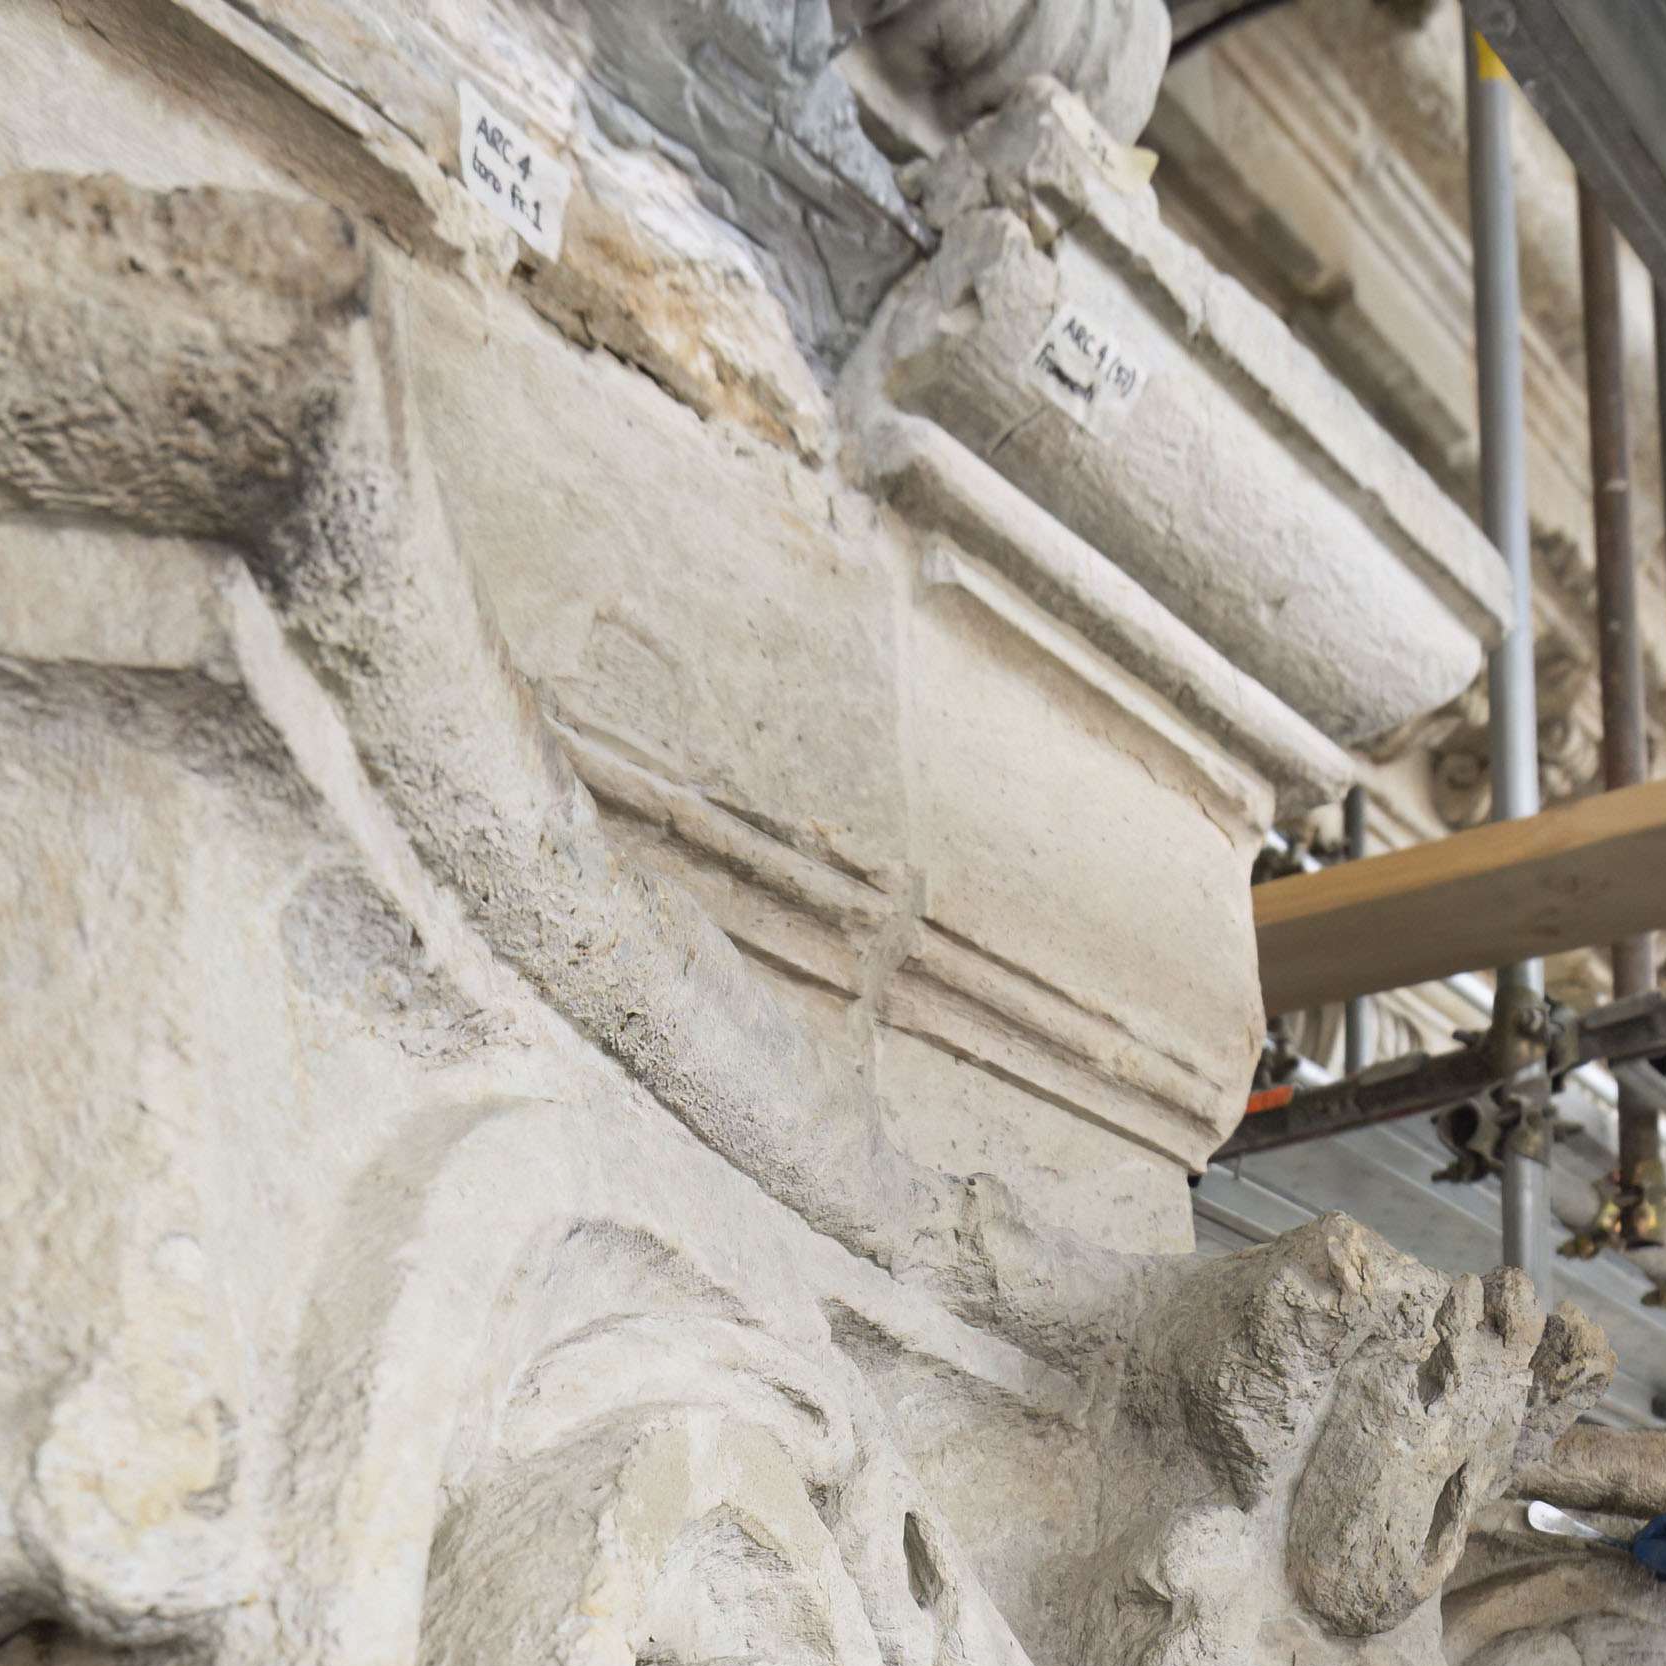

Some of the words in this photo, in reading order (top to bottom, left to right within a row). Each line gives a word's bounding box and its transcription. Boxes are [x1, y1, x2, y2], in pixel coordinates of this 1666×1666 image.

[477, 116, 513, 164] ARC
[518, 156, 531, 180] 4
[1063, 317, 1095, 356] ARC
